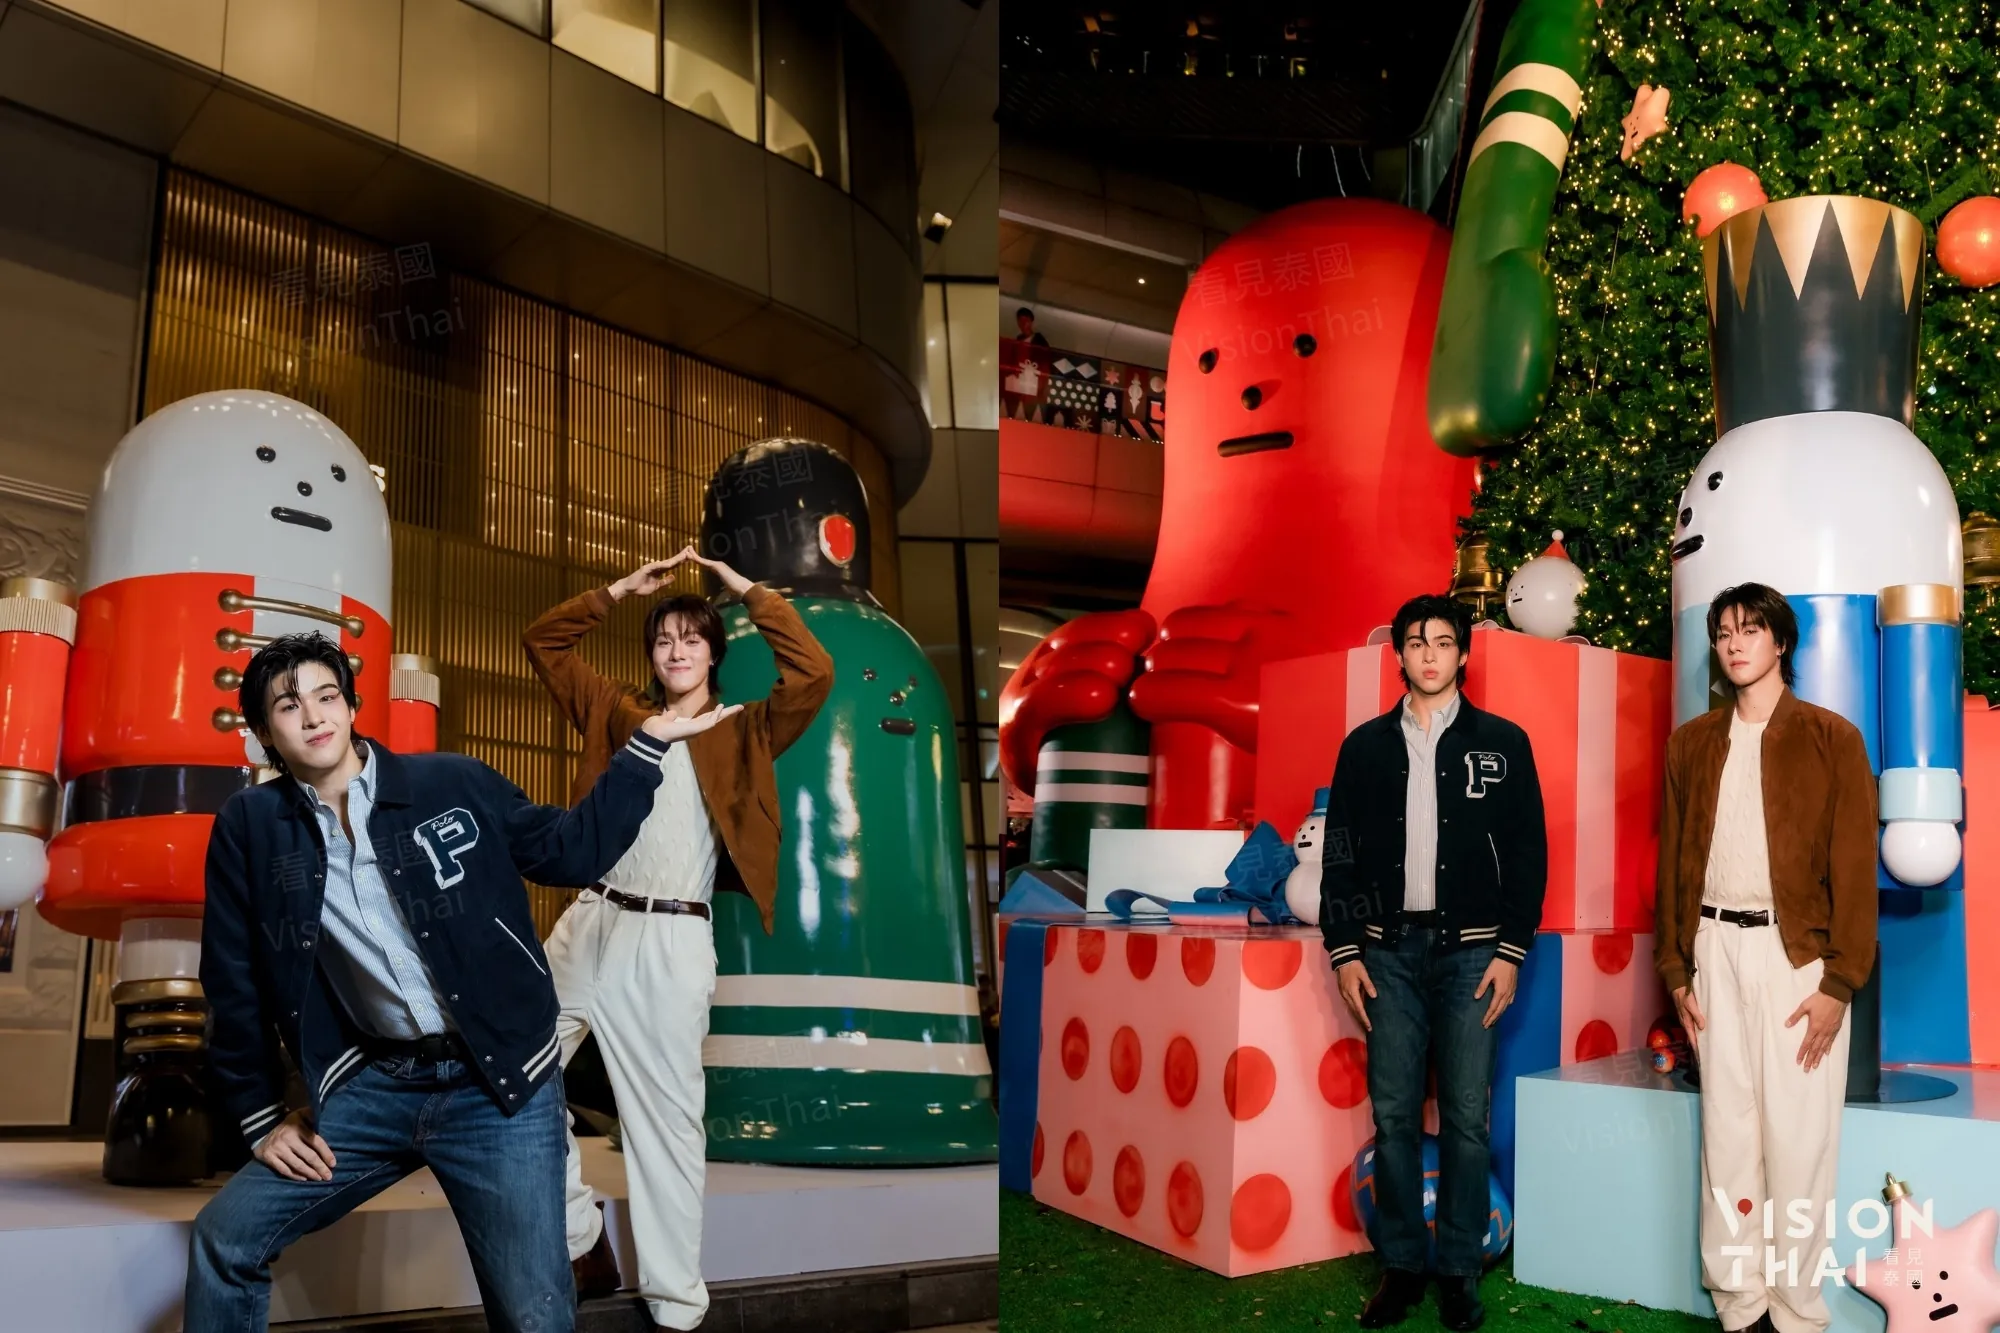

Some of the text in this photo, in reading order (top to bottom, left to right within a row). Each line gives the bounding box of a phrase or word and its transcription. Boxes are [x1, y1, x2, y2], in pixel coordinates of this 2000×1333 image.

[1464, 751, 1507, 799] P
[431, 815, 455, 831] Polo
[413, 807, 480, 890] P
